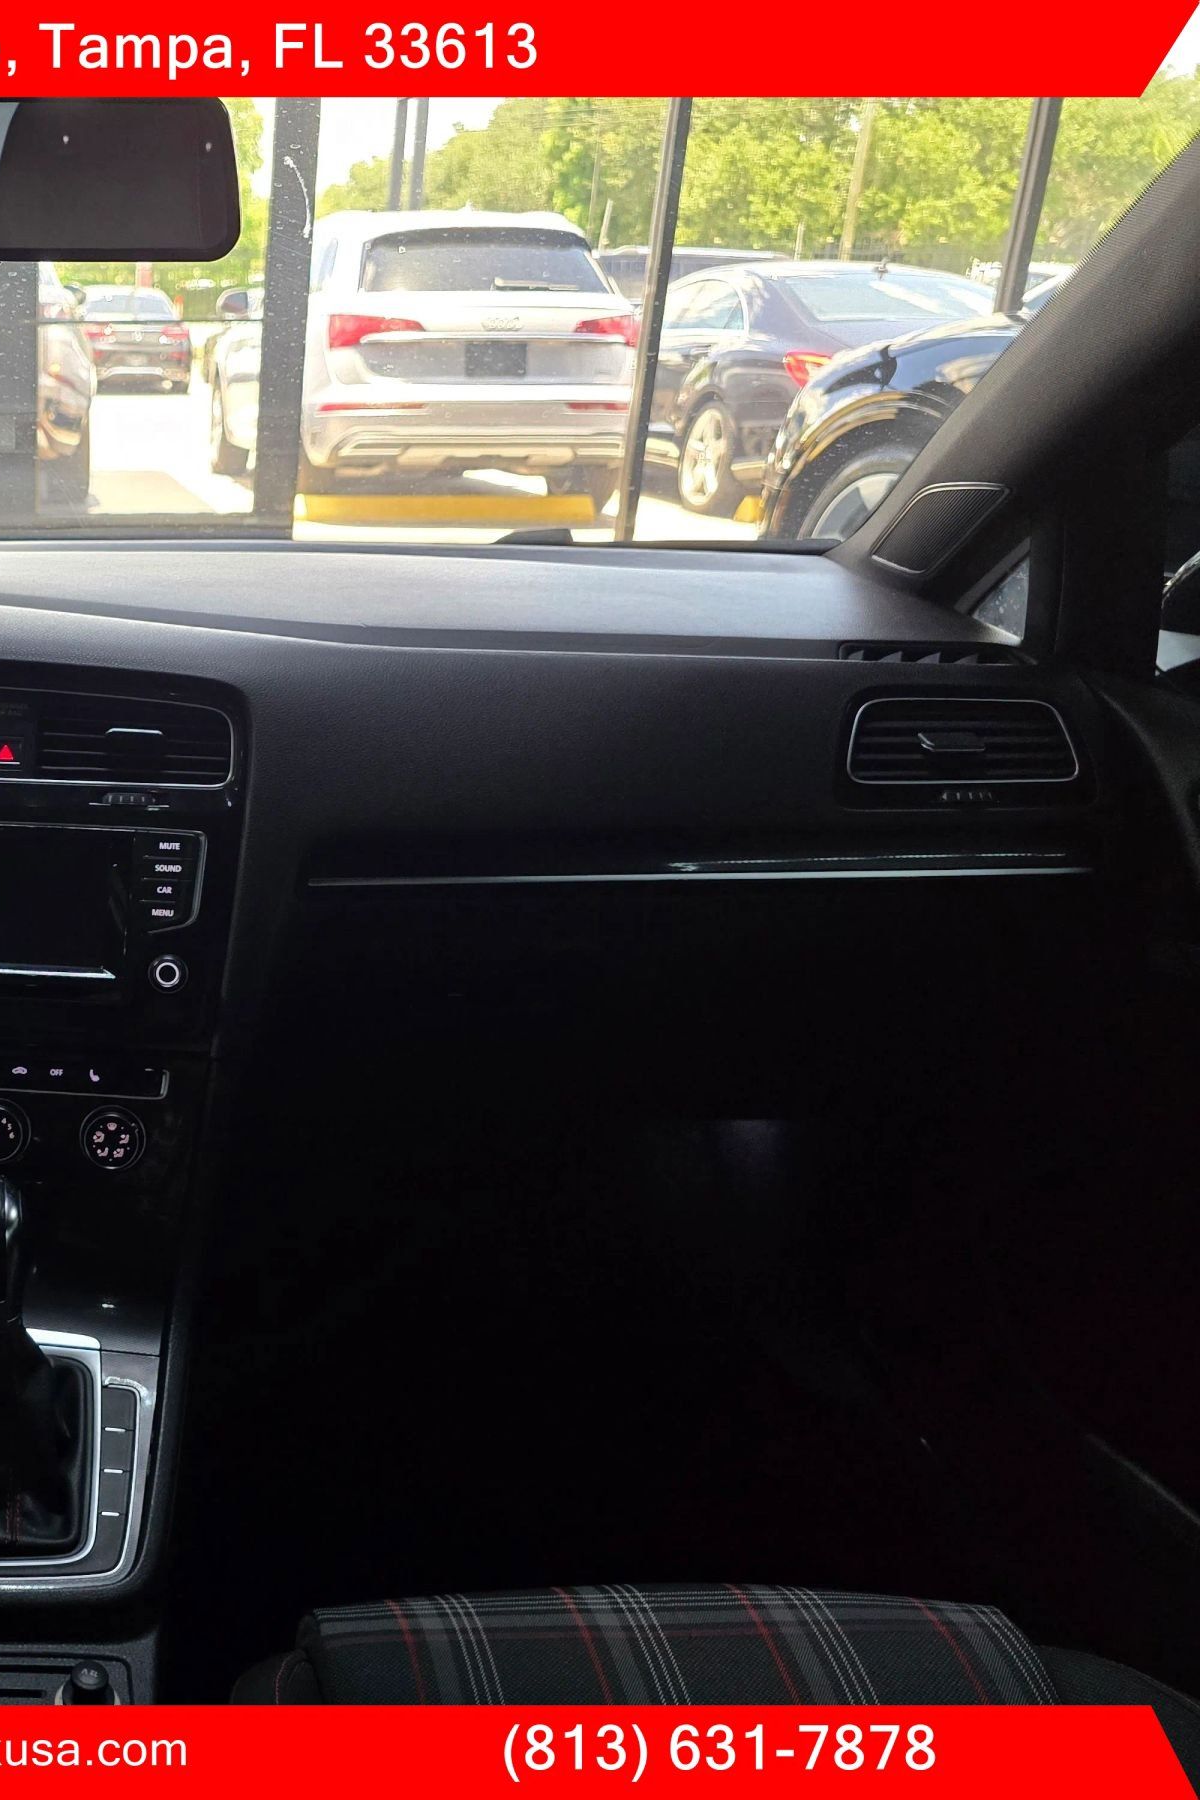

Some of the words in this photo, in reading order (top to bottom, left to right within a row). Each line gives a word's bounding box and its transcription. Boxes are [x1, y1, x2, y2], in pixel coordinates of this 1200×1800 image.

[158, 841, 181, 850] MUTE
[154, 864, 183, 873] SOUND
[156, 885, 173, 894] CAR
[151, 908, 175, 917] MENU
[49, 1068, 64, 1077] OFF
